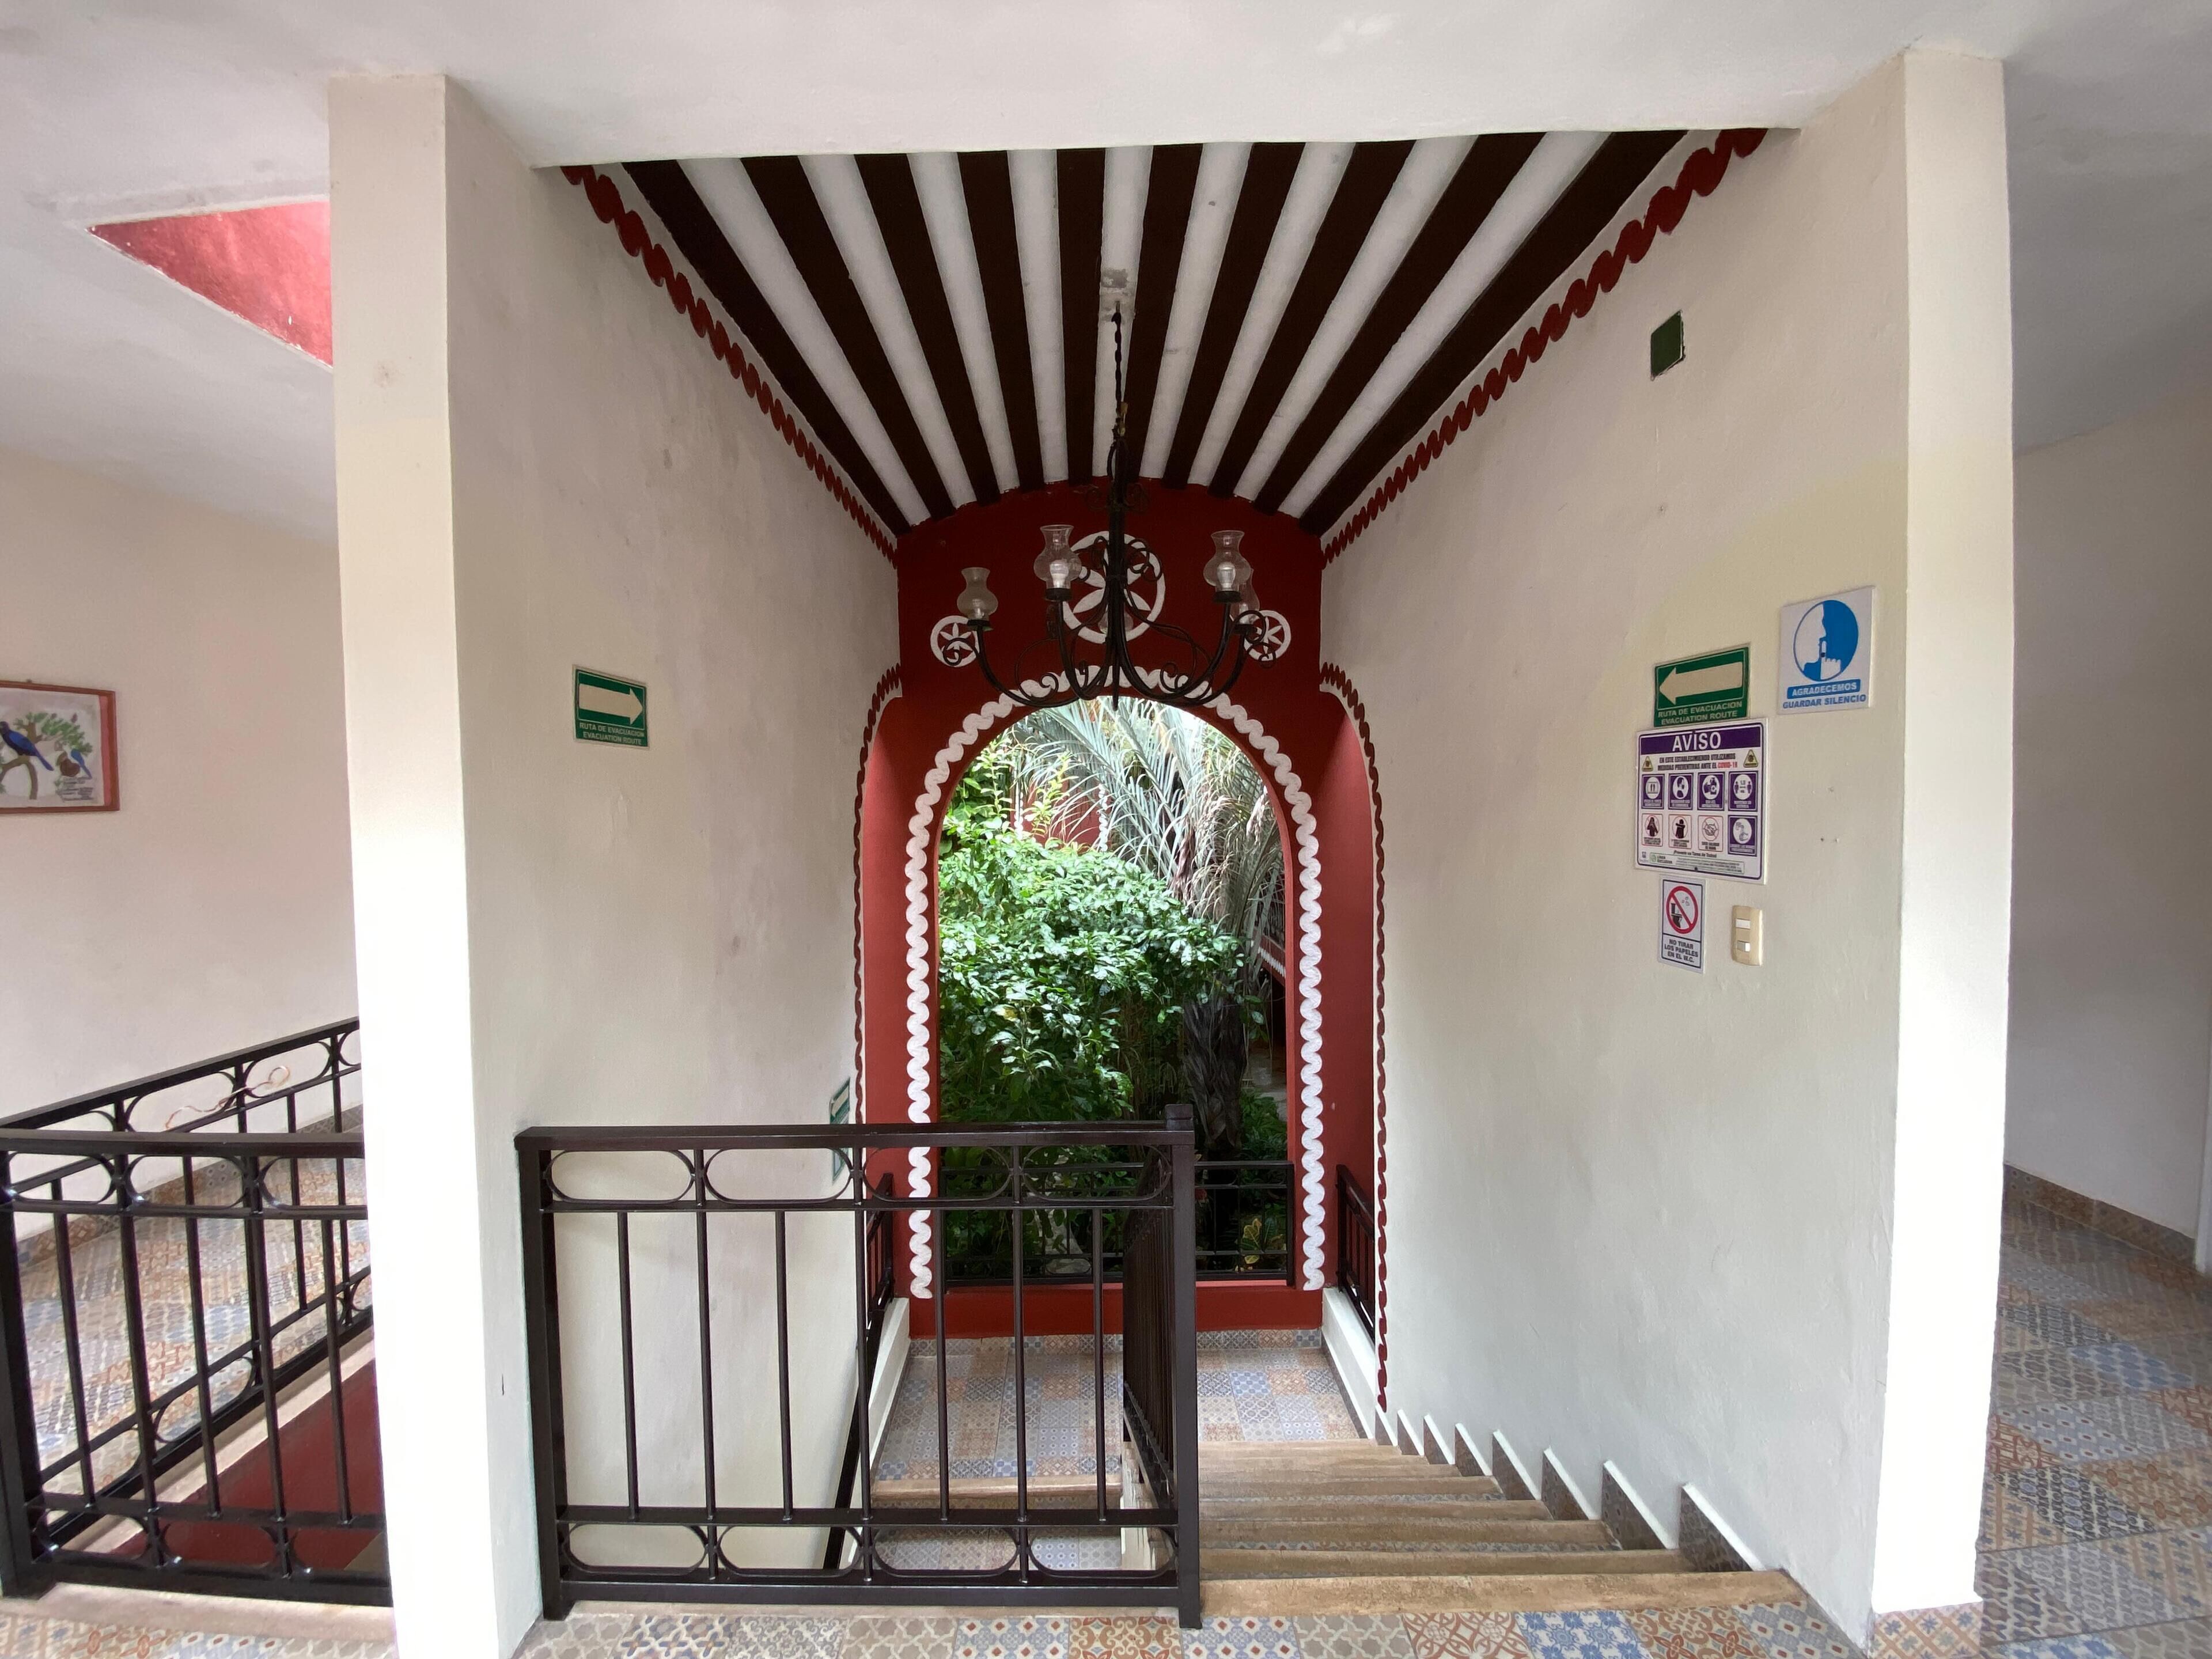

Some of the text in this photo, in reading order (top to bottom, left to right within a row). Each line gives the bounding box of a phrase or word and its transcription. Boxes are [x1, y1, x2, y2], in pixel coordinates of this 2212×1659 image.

[1791, 682, 1857, 696] AGRADECEMOS
[1783, 694, 1866, 709] GUARDAR SILENCIO
[1658, 710, 1677, 718] RUTA
[1661, 710, 1738, 725] EVACUATION ROUTE
[579, 722, 597, 730] RUTA
[583, 731, 643, 745] EVACUATION ROUTE
[1672, 731, 1722, 752] AVISO
[1675, 946, 1698, 957] PAPELES
[1677, 941, 1694, 949] TIRAR
